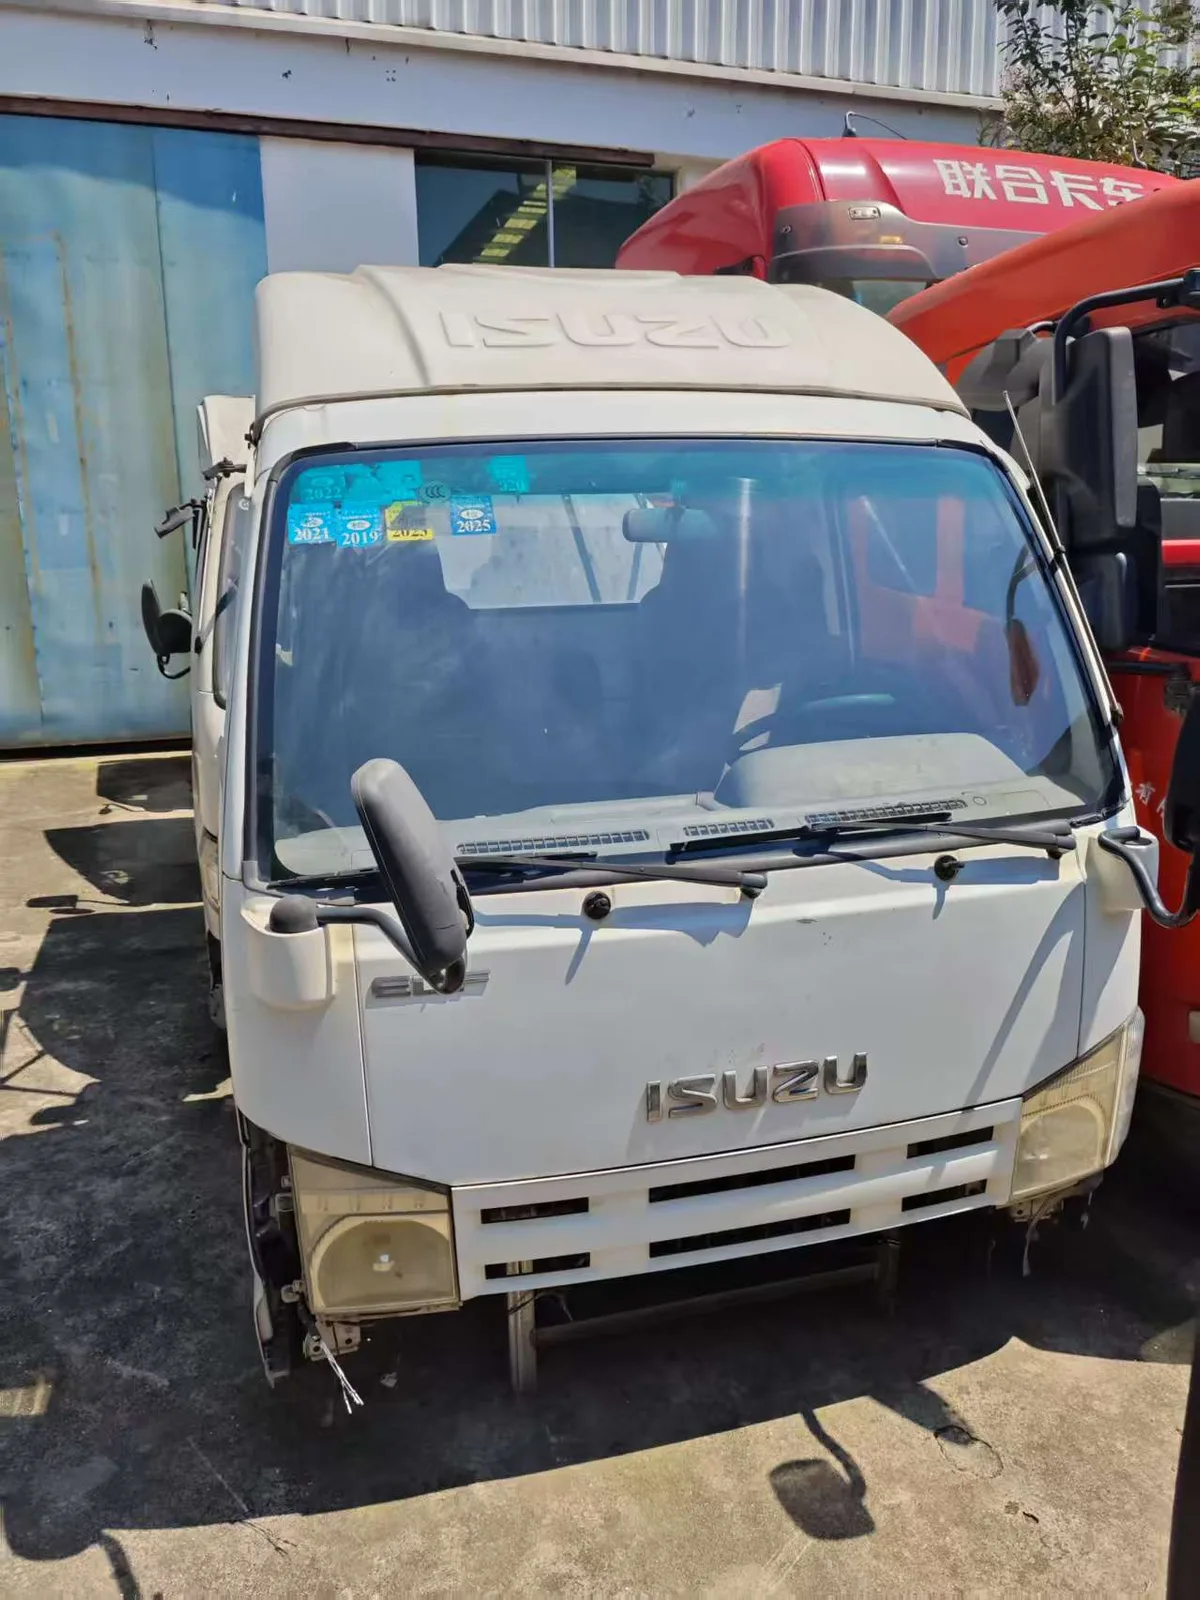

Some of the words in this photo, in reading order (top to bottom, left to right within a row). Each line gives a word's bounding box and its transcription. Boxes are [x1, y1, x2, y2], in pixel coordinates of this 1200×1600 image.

[933, 159, 1144, 210] 联合卡车
[438, 308, 791, 350] ISUZU
[294, 527, 331, 541] 2021
[342, 530, 379, 545] 2019
[456, 519, 491, 533] 2025
[646, 1051, 868, 1123] ISUZU
